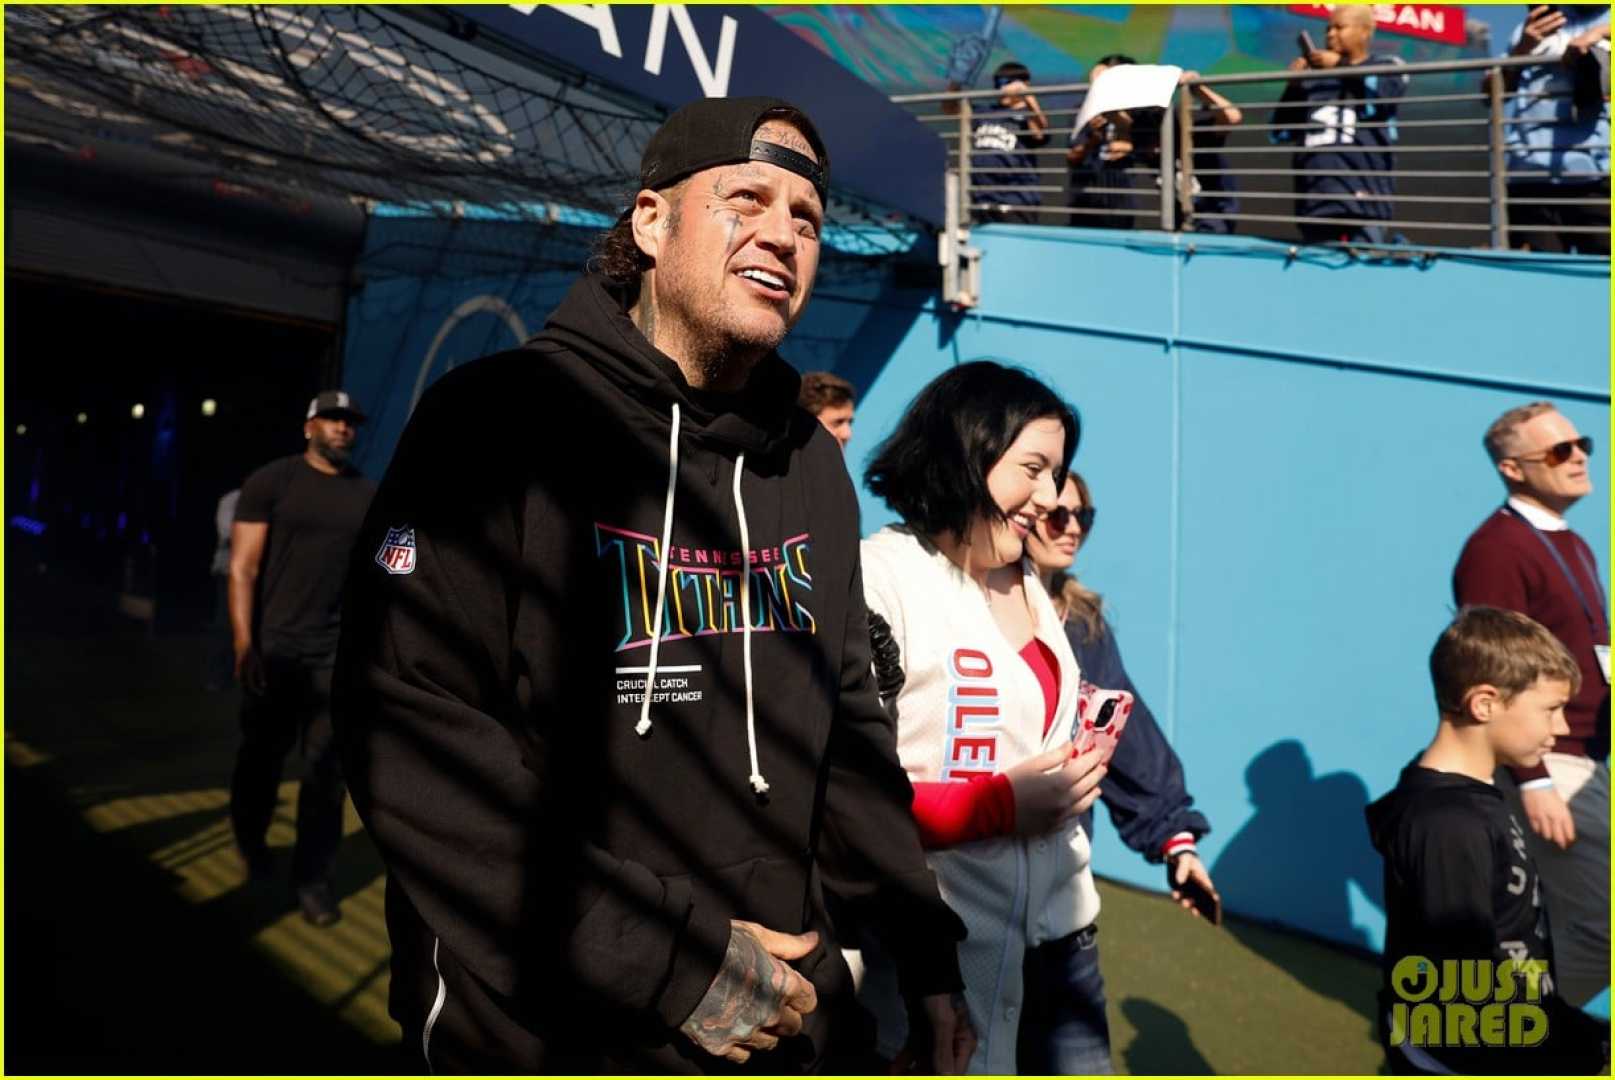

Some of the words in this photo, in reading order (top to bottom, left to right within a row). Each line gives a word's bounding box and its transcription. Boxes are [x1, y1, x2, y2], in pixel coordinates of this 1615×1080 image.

[384, 548, 413, 569] NFL
[595, 522, 816, 652] TITANS
[616, 679, 660, 690] CRUCIL
[660, 678, 688, 689] CATCH
[671, 690, 703, 702] CANCER
